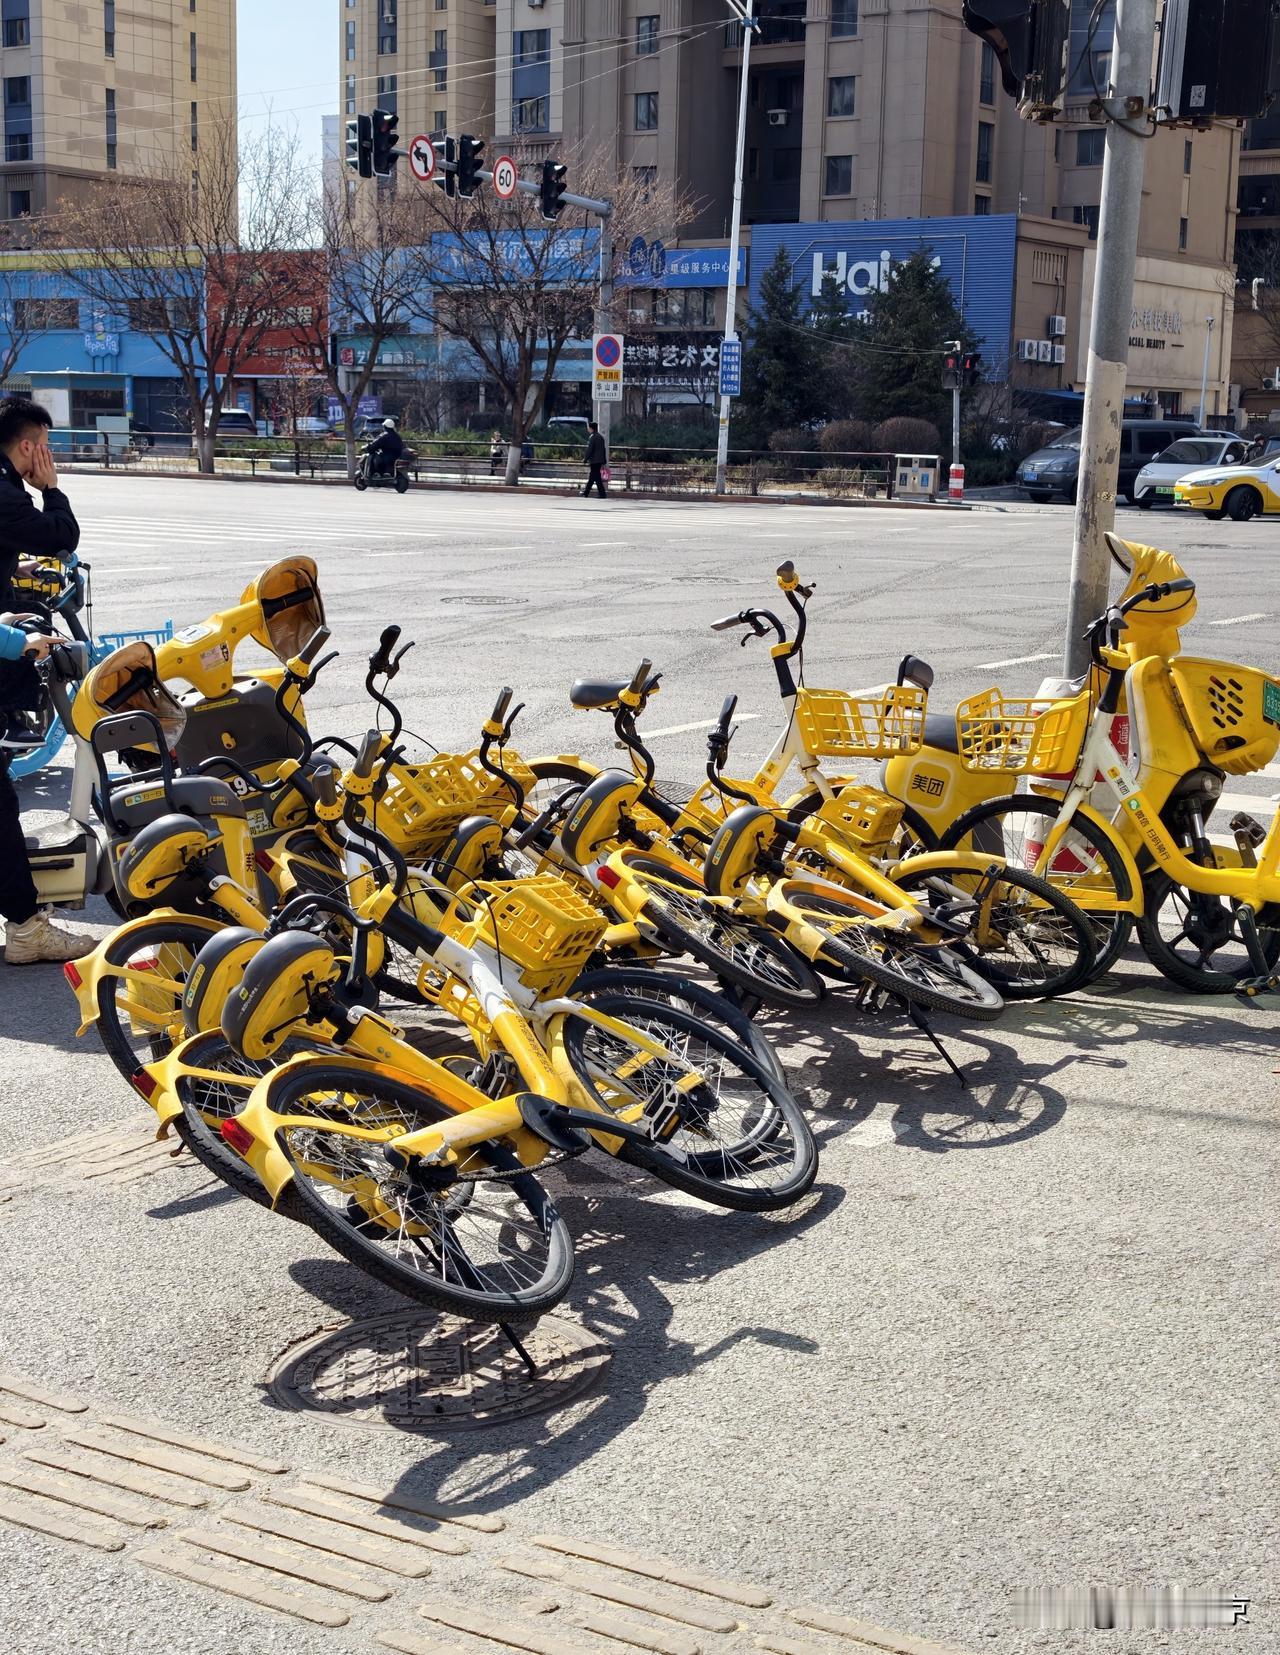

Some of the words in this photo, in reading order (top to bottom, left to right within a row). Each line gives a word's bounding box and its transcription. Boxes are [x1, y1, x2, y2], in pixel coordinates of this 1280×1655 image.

[498, 168, 512, 188] 60
[660, 262, 741, 275] 星级服务中心
[811, 249, 942, 297] Hai
[84, 334, 106, 353] Peppa
[1128, 336, 1145, 348] ACIAL
[1146, 338, 1166, 350] BEAUTY
[661, 345, 720, 367] 艺术文
[911, 774, 945, 797] 美团
[1116, 777, 1131, 796] 美团
[1130, 810, 1150, 828] 微信
